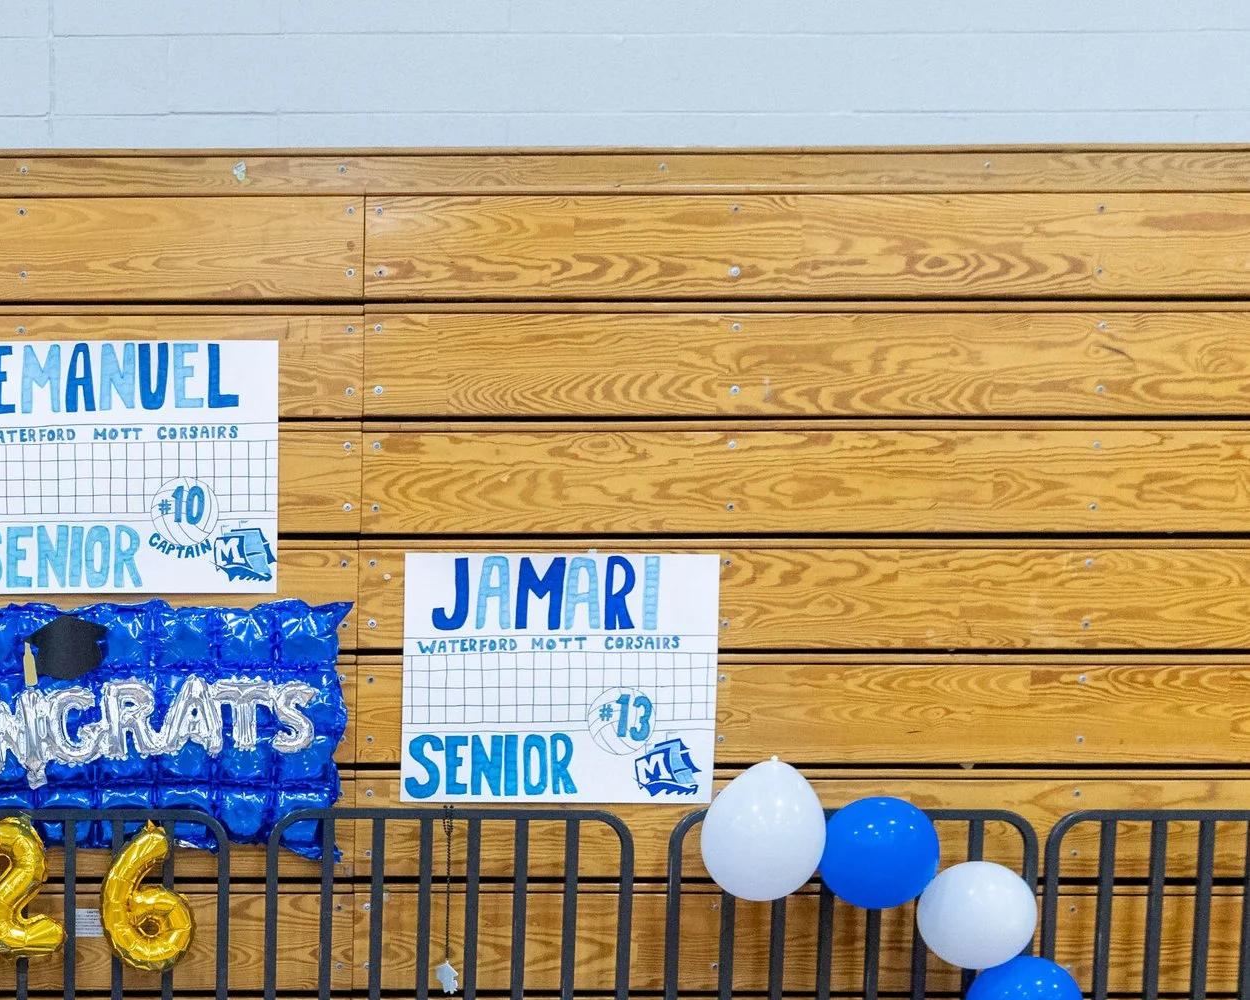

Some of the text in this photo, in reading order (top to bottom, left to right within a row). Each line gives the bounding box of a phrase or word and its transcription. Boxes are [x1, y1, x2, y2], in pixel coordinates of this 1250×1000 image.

[94, 427, 143, 441] MOTT
[157, 425, 239, 440] CORSAIRS
[158, 485, 205, 525] #10
[148, 532, 212, 559] CAPTAIN
[432, 555, 661, 630] JAMARI
[417, 635, 681, 655] WATERFORD MOTT CORSAIRS
[599, 694, 653, 742] #13
[404, 732, 578, 799] SENIOR
